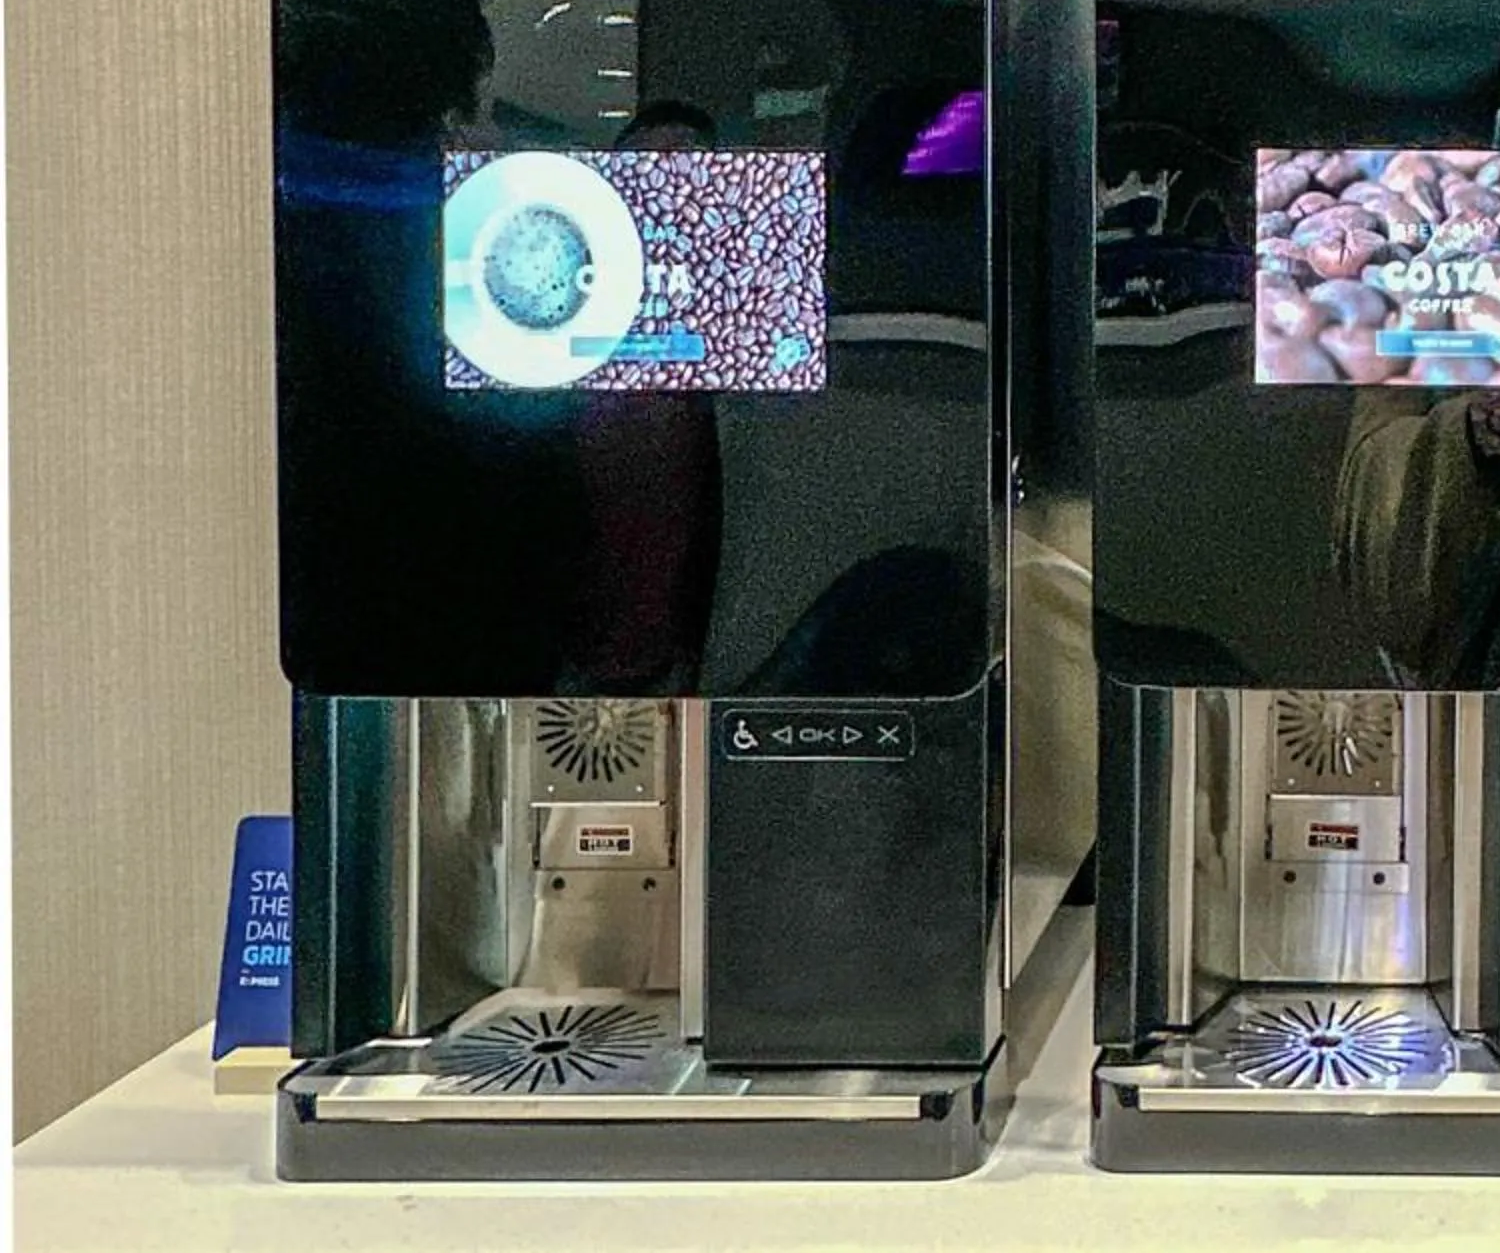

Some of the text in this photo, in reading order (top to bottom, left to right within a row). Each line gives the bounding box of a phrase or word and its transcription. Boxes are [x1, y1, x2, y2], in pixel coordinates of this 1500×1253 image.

[1383, 260, 1498, 296] COSTA
[1409, 299, 1474, 313] COFFEE
[800, 728, 836, 743] OK
[249, 895, 289, 916] THE
